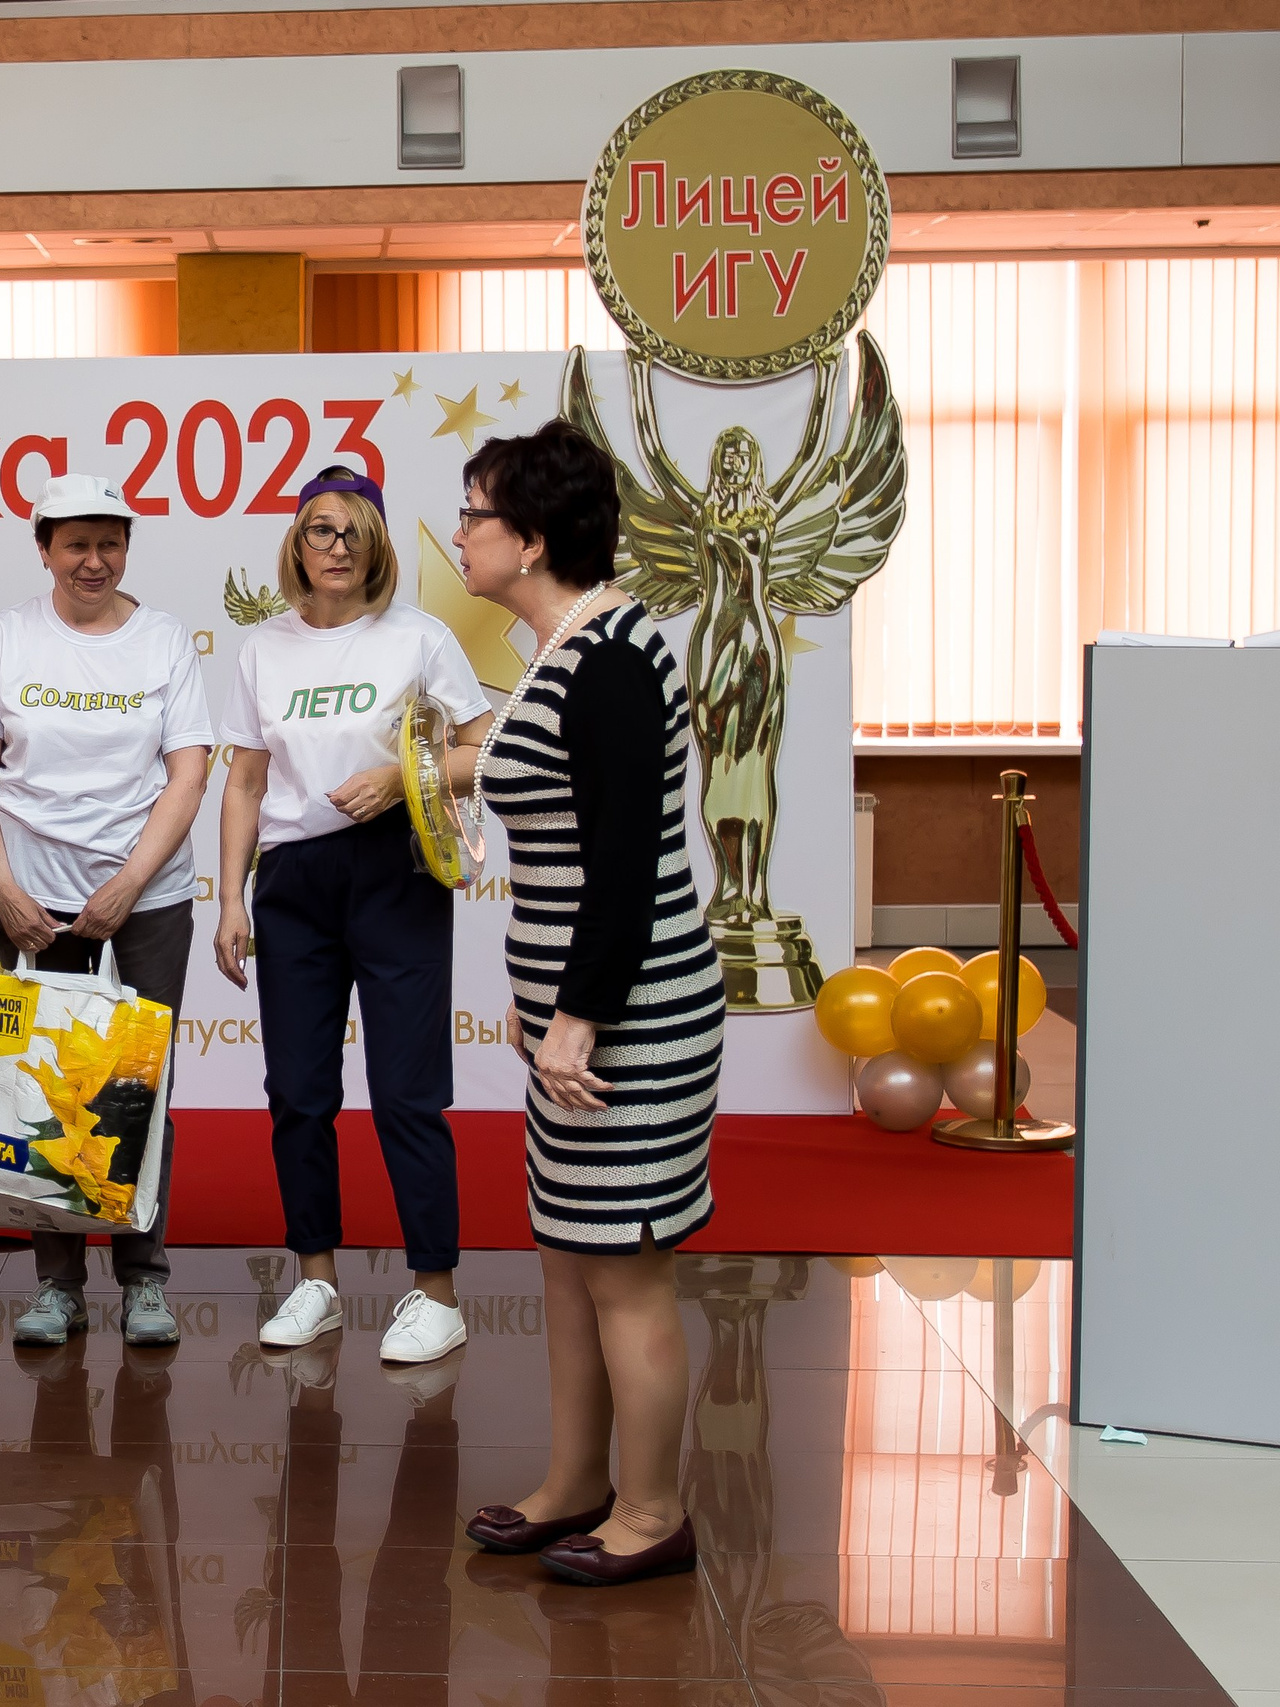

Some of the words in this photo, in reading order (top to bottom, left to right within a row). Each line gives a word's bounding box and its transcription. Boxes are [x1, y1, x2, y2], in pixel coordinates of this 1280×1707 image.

[621, 157, 850, 236] Лицей
[671, 247, 809, 323] ИГУ
[105, 398, 386, 519] 2023
[20, 683, 145, 714] Солнце
[282, 682, 377, 721] ЛЕТО
